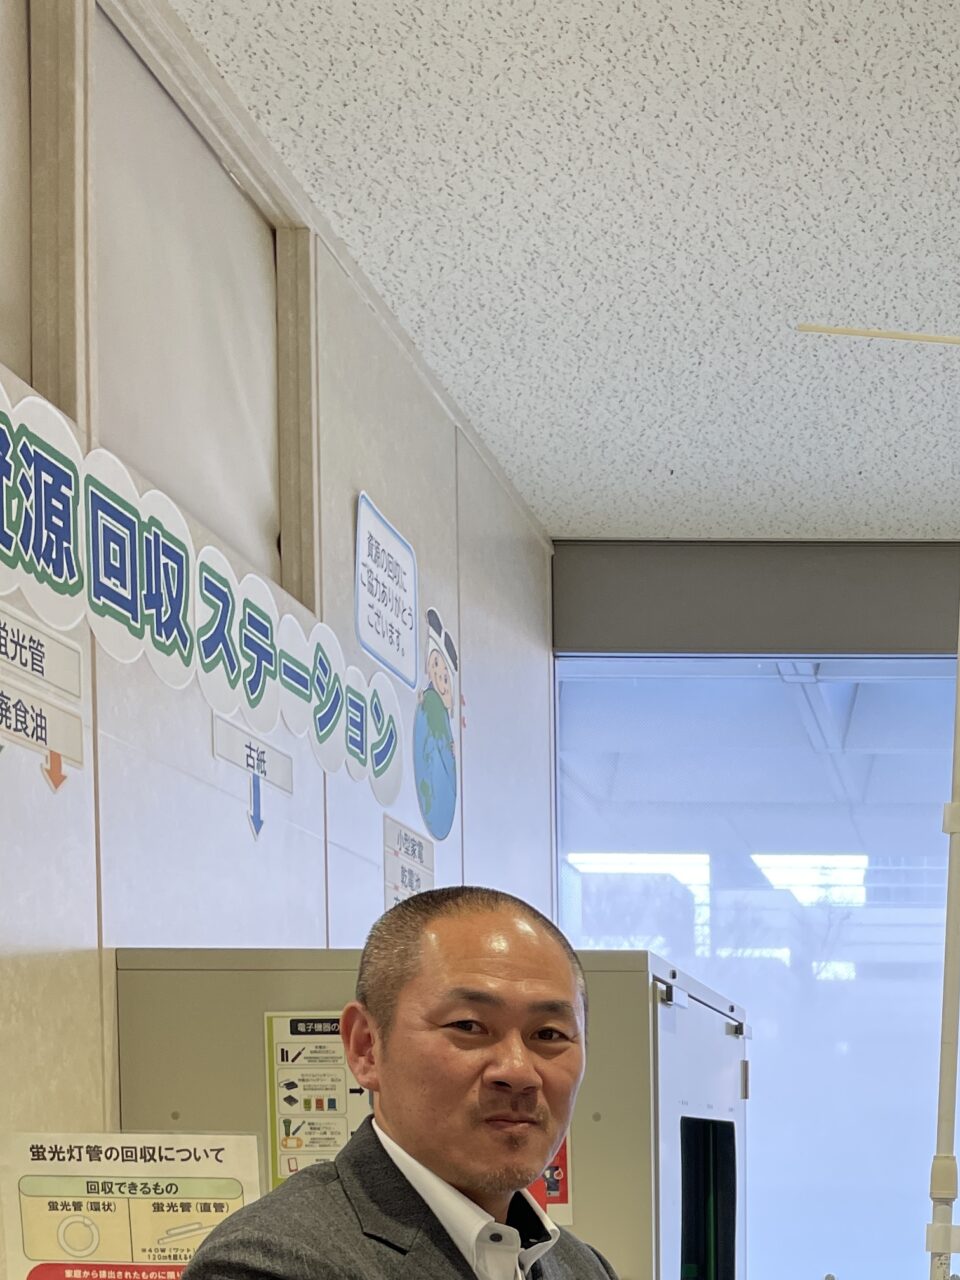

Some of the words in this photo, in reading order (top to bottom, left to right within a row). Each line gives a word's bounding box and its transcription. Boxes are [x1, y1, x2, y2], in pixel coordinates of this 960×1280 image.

[0, 412, 397, 780] 源回収ステーション
[244, 741, 267, 776] 古紙
[29, 1144, 226, 1164] 蛍光灯管の回収について
[86, 1180, 179, 1195] 回収できるもの
